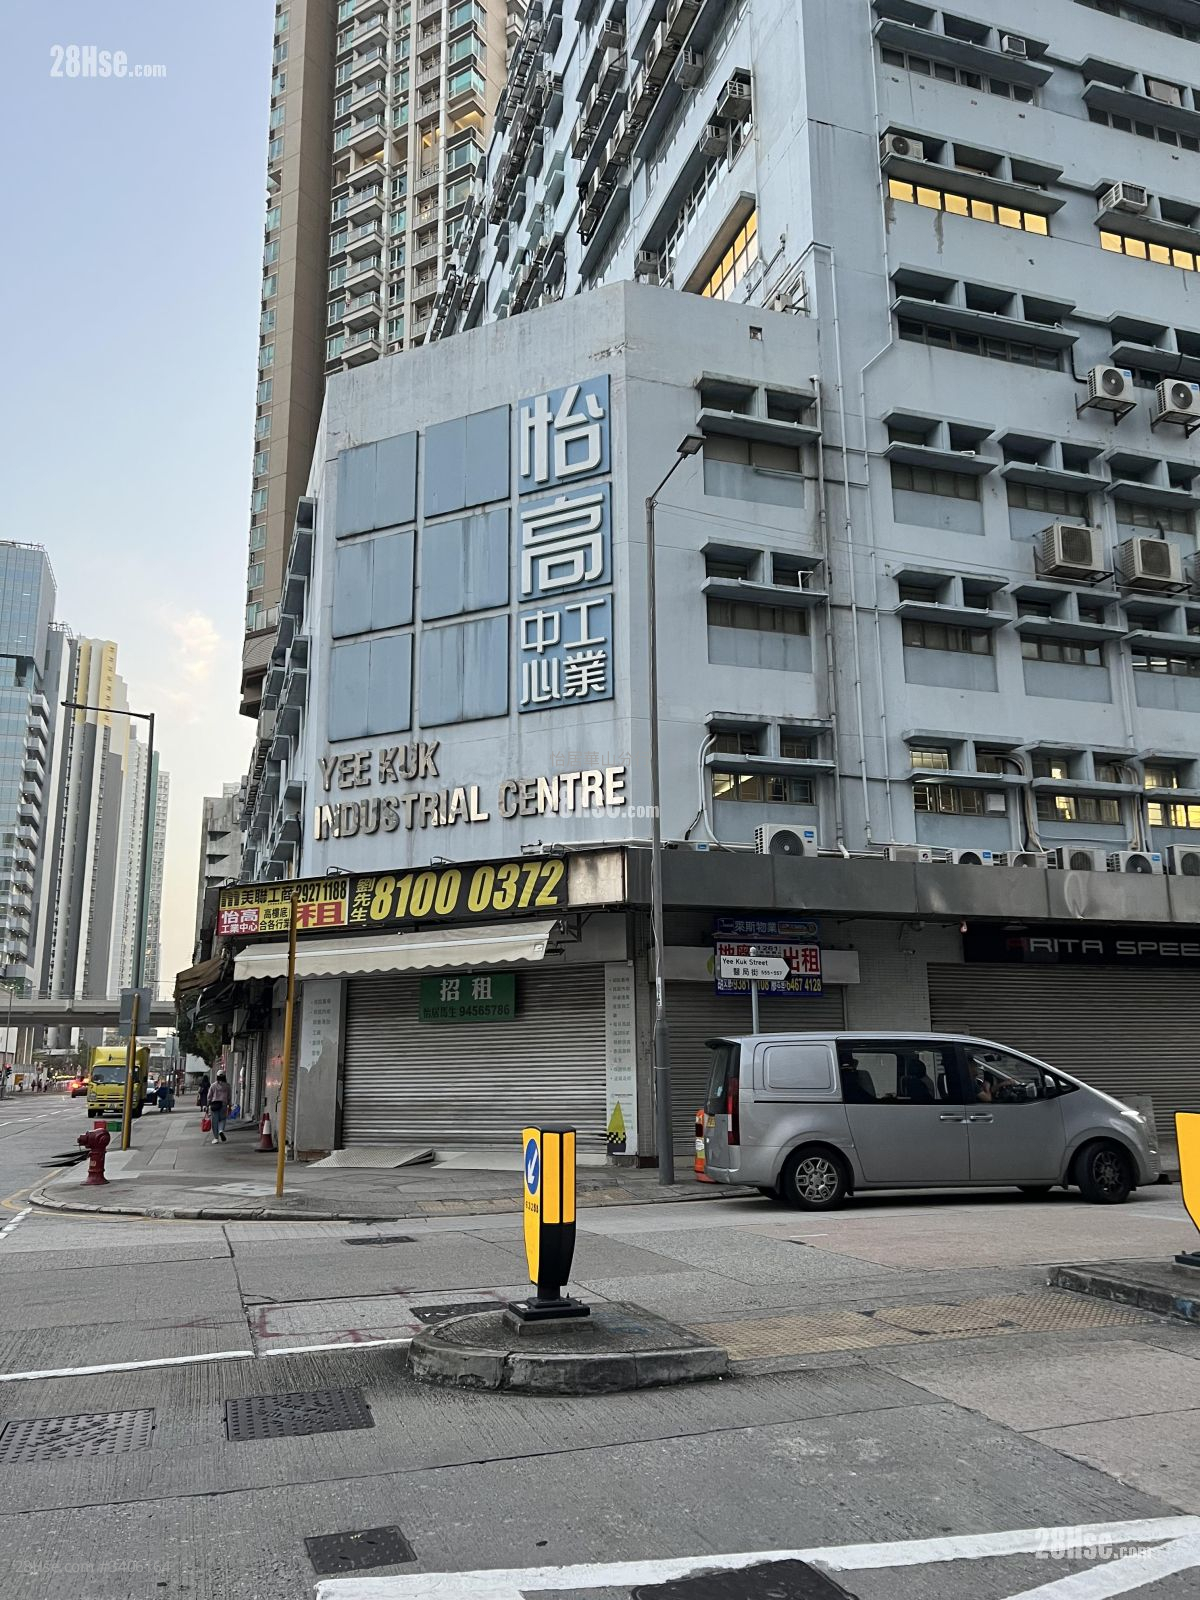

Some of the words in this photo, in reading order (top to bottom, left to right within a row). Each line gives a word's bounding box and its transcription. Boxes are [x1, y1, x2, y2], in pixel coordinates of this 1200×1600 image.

[520, 385, 605, 596] 怡高
[318, 751, 372, 792] YEE
[379, 741, 440, 784] KUK
[314, 785, 491, 840] INDUSTRIAL
[499, 766, 626, 819] CENTRE
[241, 886, 293, 906] 美聯工商
[295, 882, 321, 903] 2927
[322, 880, 347, 900] 1188
[350, 877, 375, 922] 劉先生
[370, 869, 462, 921] 8100
[467, 859, 565, 912] 0372
[220, 922, 258, 934] 工業中心
[221, 909, 259, 925] 怡高
[296, 901, 345, 928] 租
[733, 967, 758, 977] 醫局街
[783, 946, 820, 973] 出租
[440, 976, 493, 1002] 招租
[459, 1004, 511, 1017] 94565786
